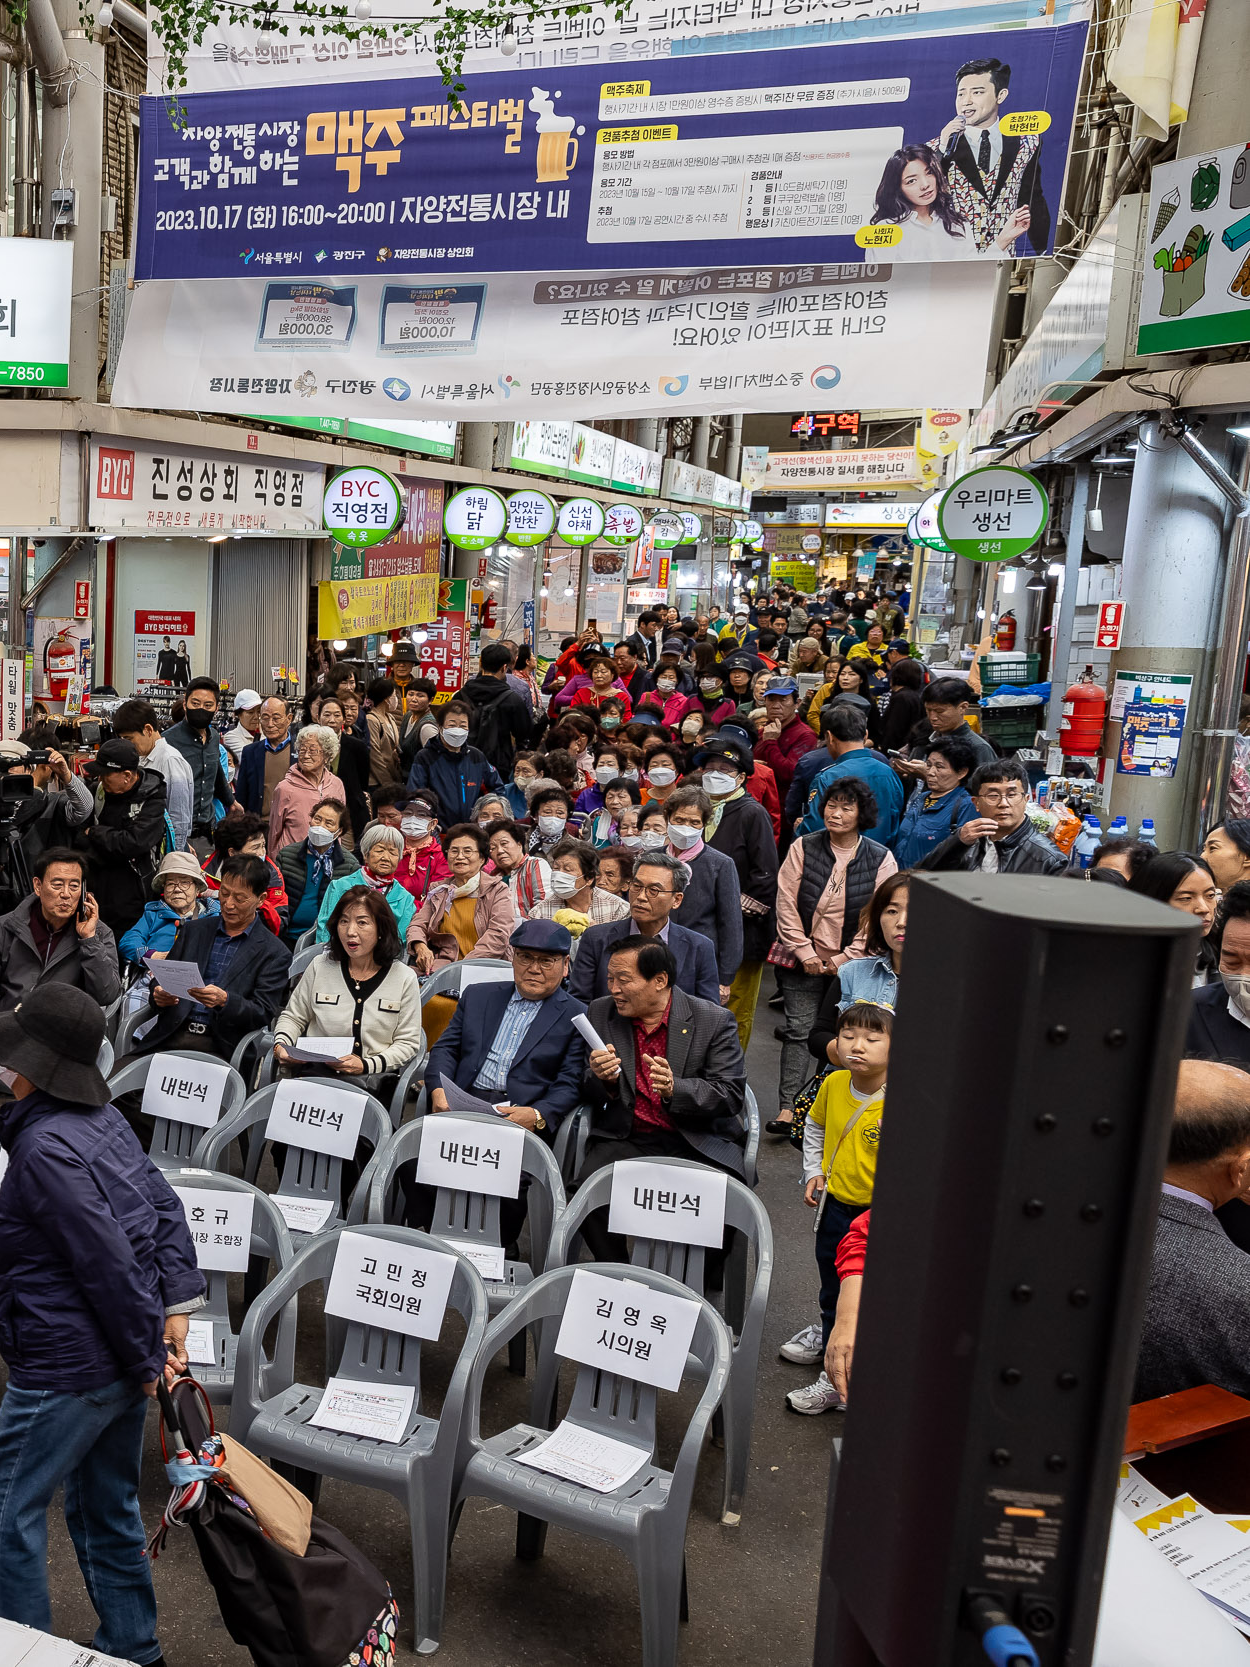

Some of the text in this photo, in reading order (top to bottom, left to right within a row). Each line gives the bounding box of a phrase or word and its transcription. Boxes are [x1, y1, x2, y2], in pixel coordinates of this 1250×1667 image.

[605, 84, 645, 97] 맥주축제
[604, 85, 907, 116] 행사기간 1만원이상 영수증 증빙시 맥주1잔 무료 증정 500원)
[601, 127, 672, 143] 경품추첨 이벤트
[1009, 122, 1040, 133] 박현빈
[305, 98, 525, 193] 맥주 페스티벌
[602, 151, 801, 172] 행사기간 점포에서 3만원이상 구매시 추첨권 증정
[603, 149, 635, 160] 응모 방법
[600, 177, 633, 189] 응모 기간
[750, 170, 783, 181] 경품안내
[599, 184, 721, 200] 2023년 10월 10월 추첨시
[155, 189, 569, 231] 2023.10.17 (화) 16:00~20:00 자양전통시장 내
[597, 206, 613, 216] 추첨
[827, 202, 847, 214] (2명)
[596, 212, 729, 227] 2023년 10월 공연시간 추첨
[745, 217, 769, 229] 행운상
[864, 234, 893, 245] 노현지
[254, 251, 303, 265] 서울특별시
[332, 249, 366, 261] 광진구
[393, 246, 475, 260] 자양전통시장 상인회
[933, 414, 958, 424] OPEN
[835, 454, 859, 464] 지키지
[861, 453, 885, 463] 못하는
[780, 463, 905, 478] 자양전통시장 질서를 해칩니다
[100, 456, 305, 508] BYC 진성상회 직영점
[341, 480, 380, 498] BYC
[466, 496, 489, 511] 하림
[953, 488, 1034, 509] 우리마트
[332, 502, 389, 524] 직영점
[510, 500, 545, 515] 맛있는
[568, 506, 592, 519] 신선
[467, 512, 484, 531] 닭
[514, 516, 539, 530] 반찬
[567, 519, 592, 531] 야채
[971, 511, 1012, 533] 생선
[977, 541, 1002, 554] 생선
[144, 623, 158, 632] BYC
[1099, 624, 1119, 632] 소화기
[8, 665, 18, 696] 타월
[160, 1075, 209, 1103] 내빈석
[289, 1101, 344, 1132] 내빈석
[439, 1140, 501, 1170] 내빈석
[633, 1186, 702, 1218] 내빈석
[213, 1233, 243, 1247] 조합장
[355, 1283, 423, 1317] 국회의원
[596, 1328, 653, 1363] 시의원
